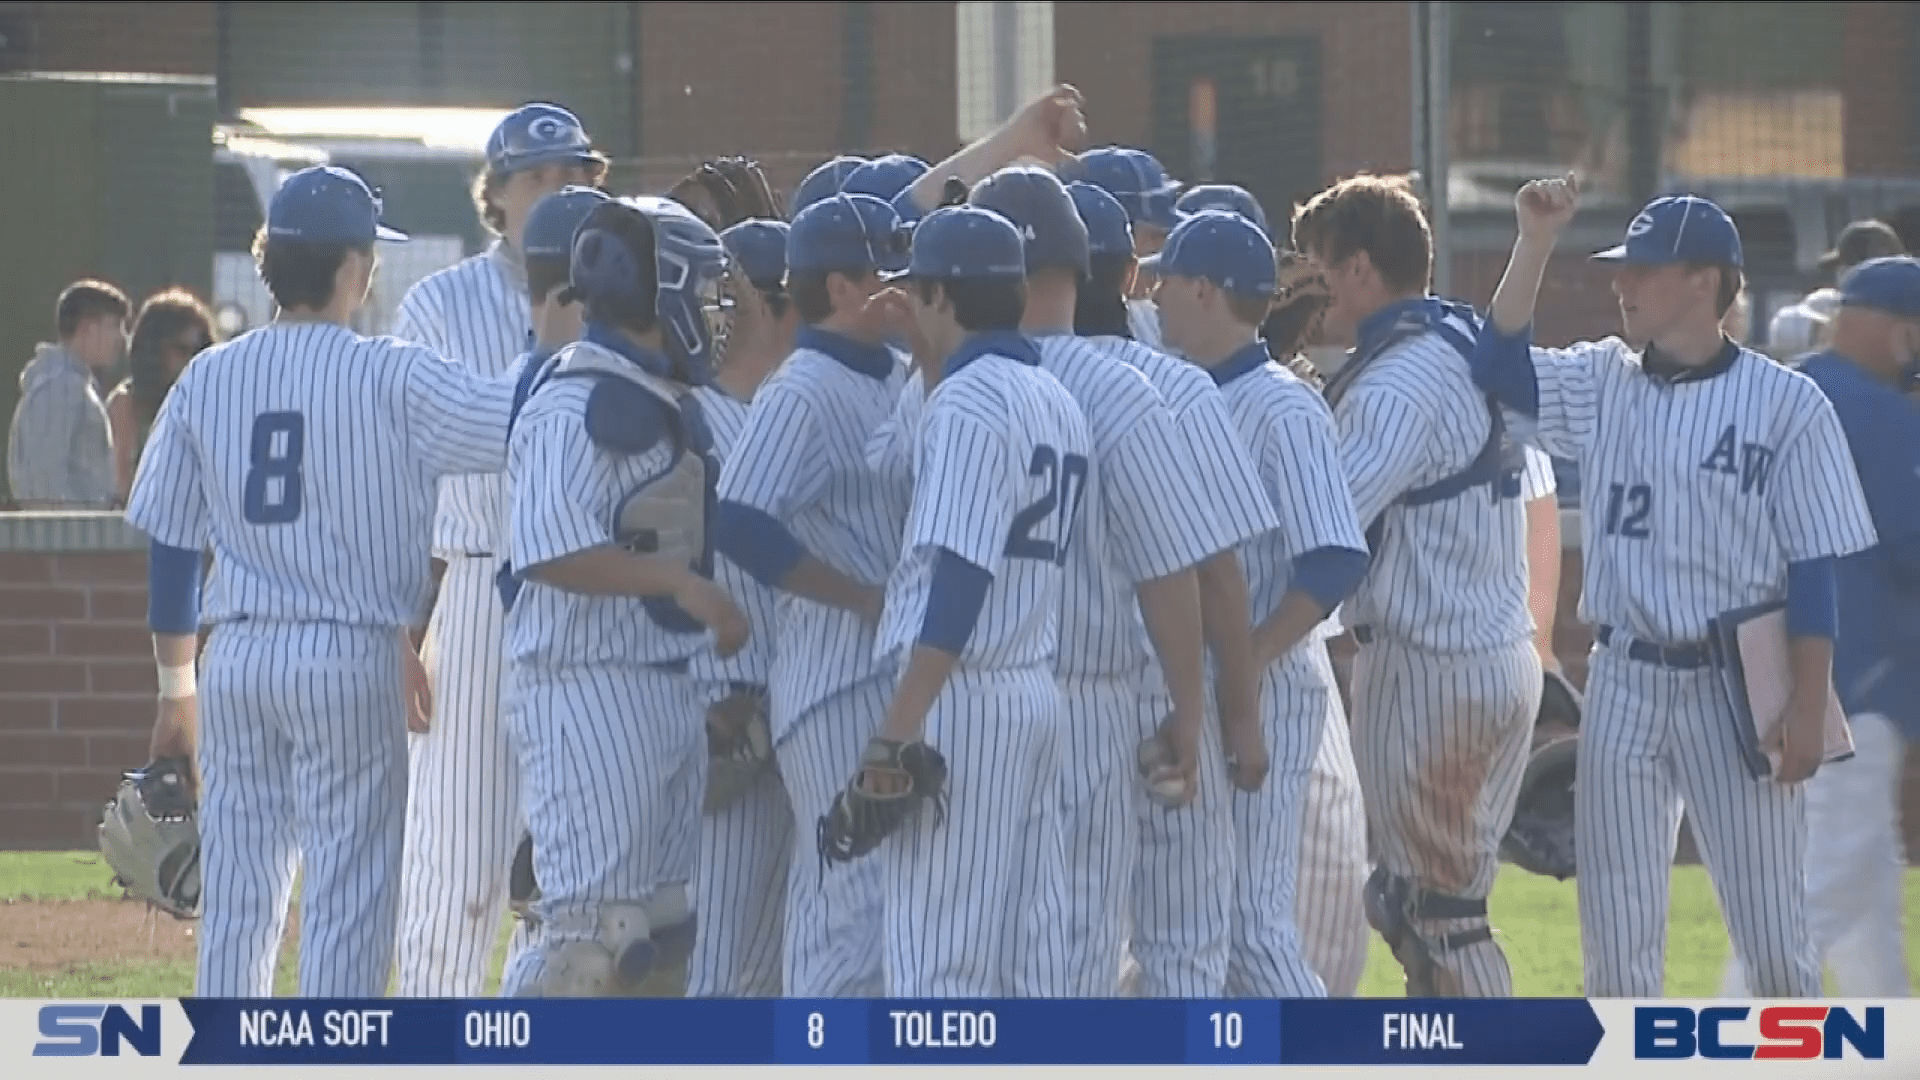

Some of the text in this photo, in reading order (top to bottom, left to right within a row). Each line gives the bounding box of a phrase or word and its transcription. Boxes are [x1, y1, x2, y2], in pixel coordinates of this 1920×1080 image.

[244, 410, 305, 524] 8
[1003, 443, 1088, 567] 20
[1700, 424, 1774, 497] AW
[1607, 482, 1651, 538] 12
